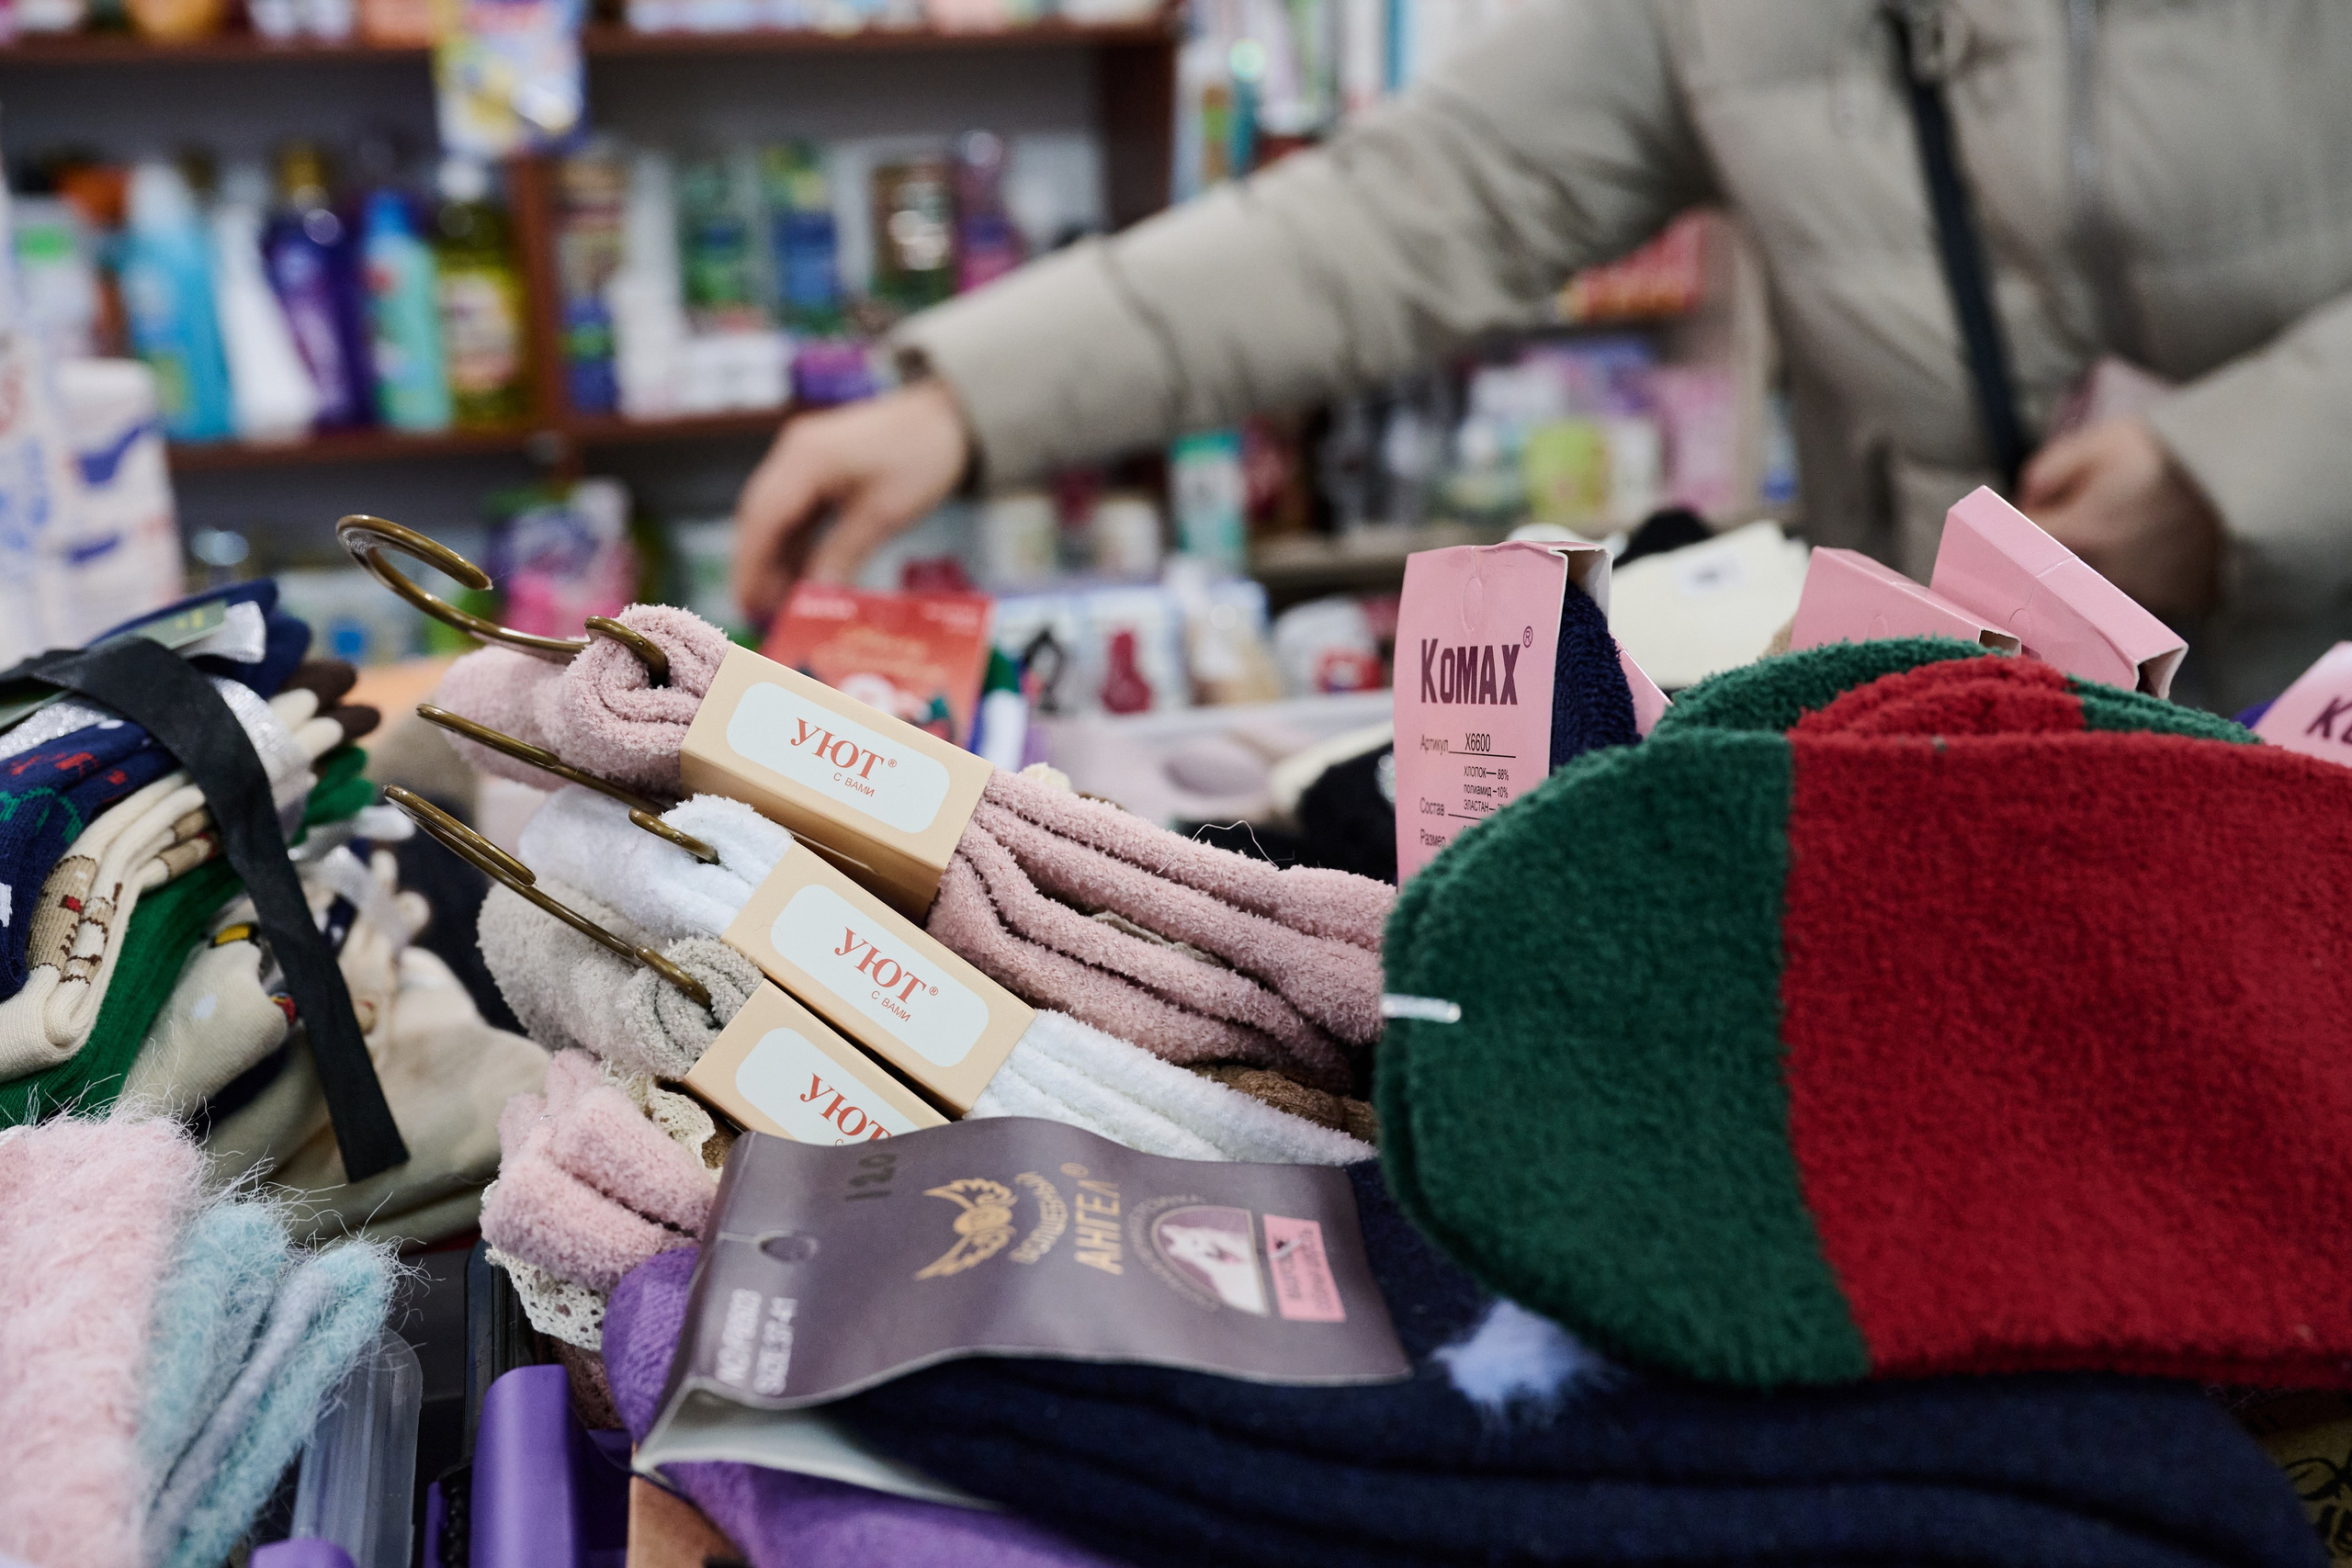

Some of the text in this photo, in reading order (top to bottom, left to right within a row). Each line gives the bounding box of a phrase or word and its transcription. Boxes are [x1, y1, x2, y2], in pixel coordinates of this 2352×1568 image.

[790, 717, 885, 780] УЮТ
[1419, 735, 1449, 755] Артикул
[844, 778, 876, 797] ВАМИ
[1419, 797, 1444, 816] Состав
[834, 927, 927, 1004] УЮТ
[881, 998, 911, 1022] ВАМИ
[1074, 1179, 1125, 1275] АНГЕЛ
